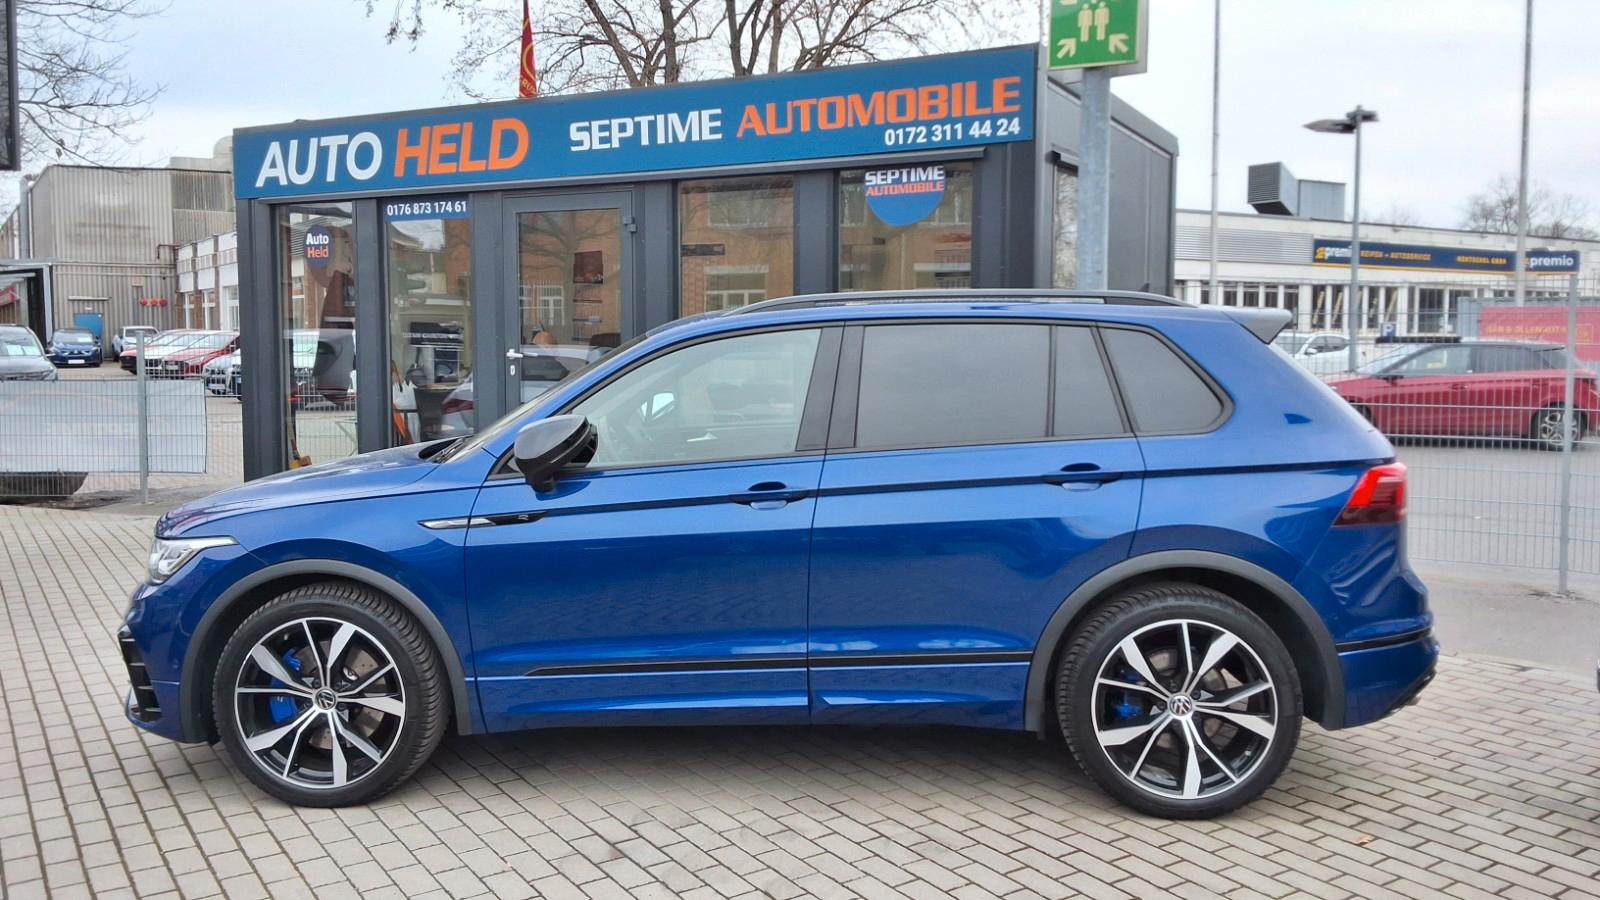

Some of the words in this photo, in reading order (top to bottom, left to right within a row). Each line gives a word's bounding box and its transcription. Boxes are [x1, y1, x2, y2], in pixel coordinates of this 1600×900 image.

[569, 108, 723, 153] SEPTIME
[736, 75, 1022, 139] AUTOMOBILE
[884, 125, 926, 147] 0172
[931, 123, 964, 144] 311
[968, 120, 993, 141] 44
[996, 117, 1021, 138] 24
[255, 131, 383, 188] AUTO
[394, 118, 529, 177] HELD
[864, 165, 945, 186] SEPTIME
[865, 181, 945, 197] AUTOMOBILE
[386, 203, 411, 216] 0176
[413, 202, 431, 215] 873
[433, 201, 453, 214] 174
[454, 200, 467, 213] 61
[306, 232, 330, 245] Auto
[307, 245, 329, 258] Held
[1530, 254, 1574, 269] premio
